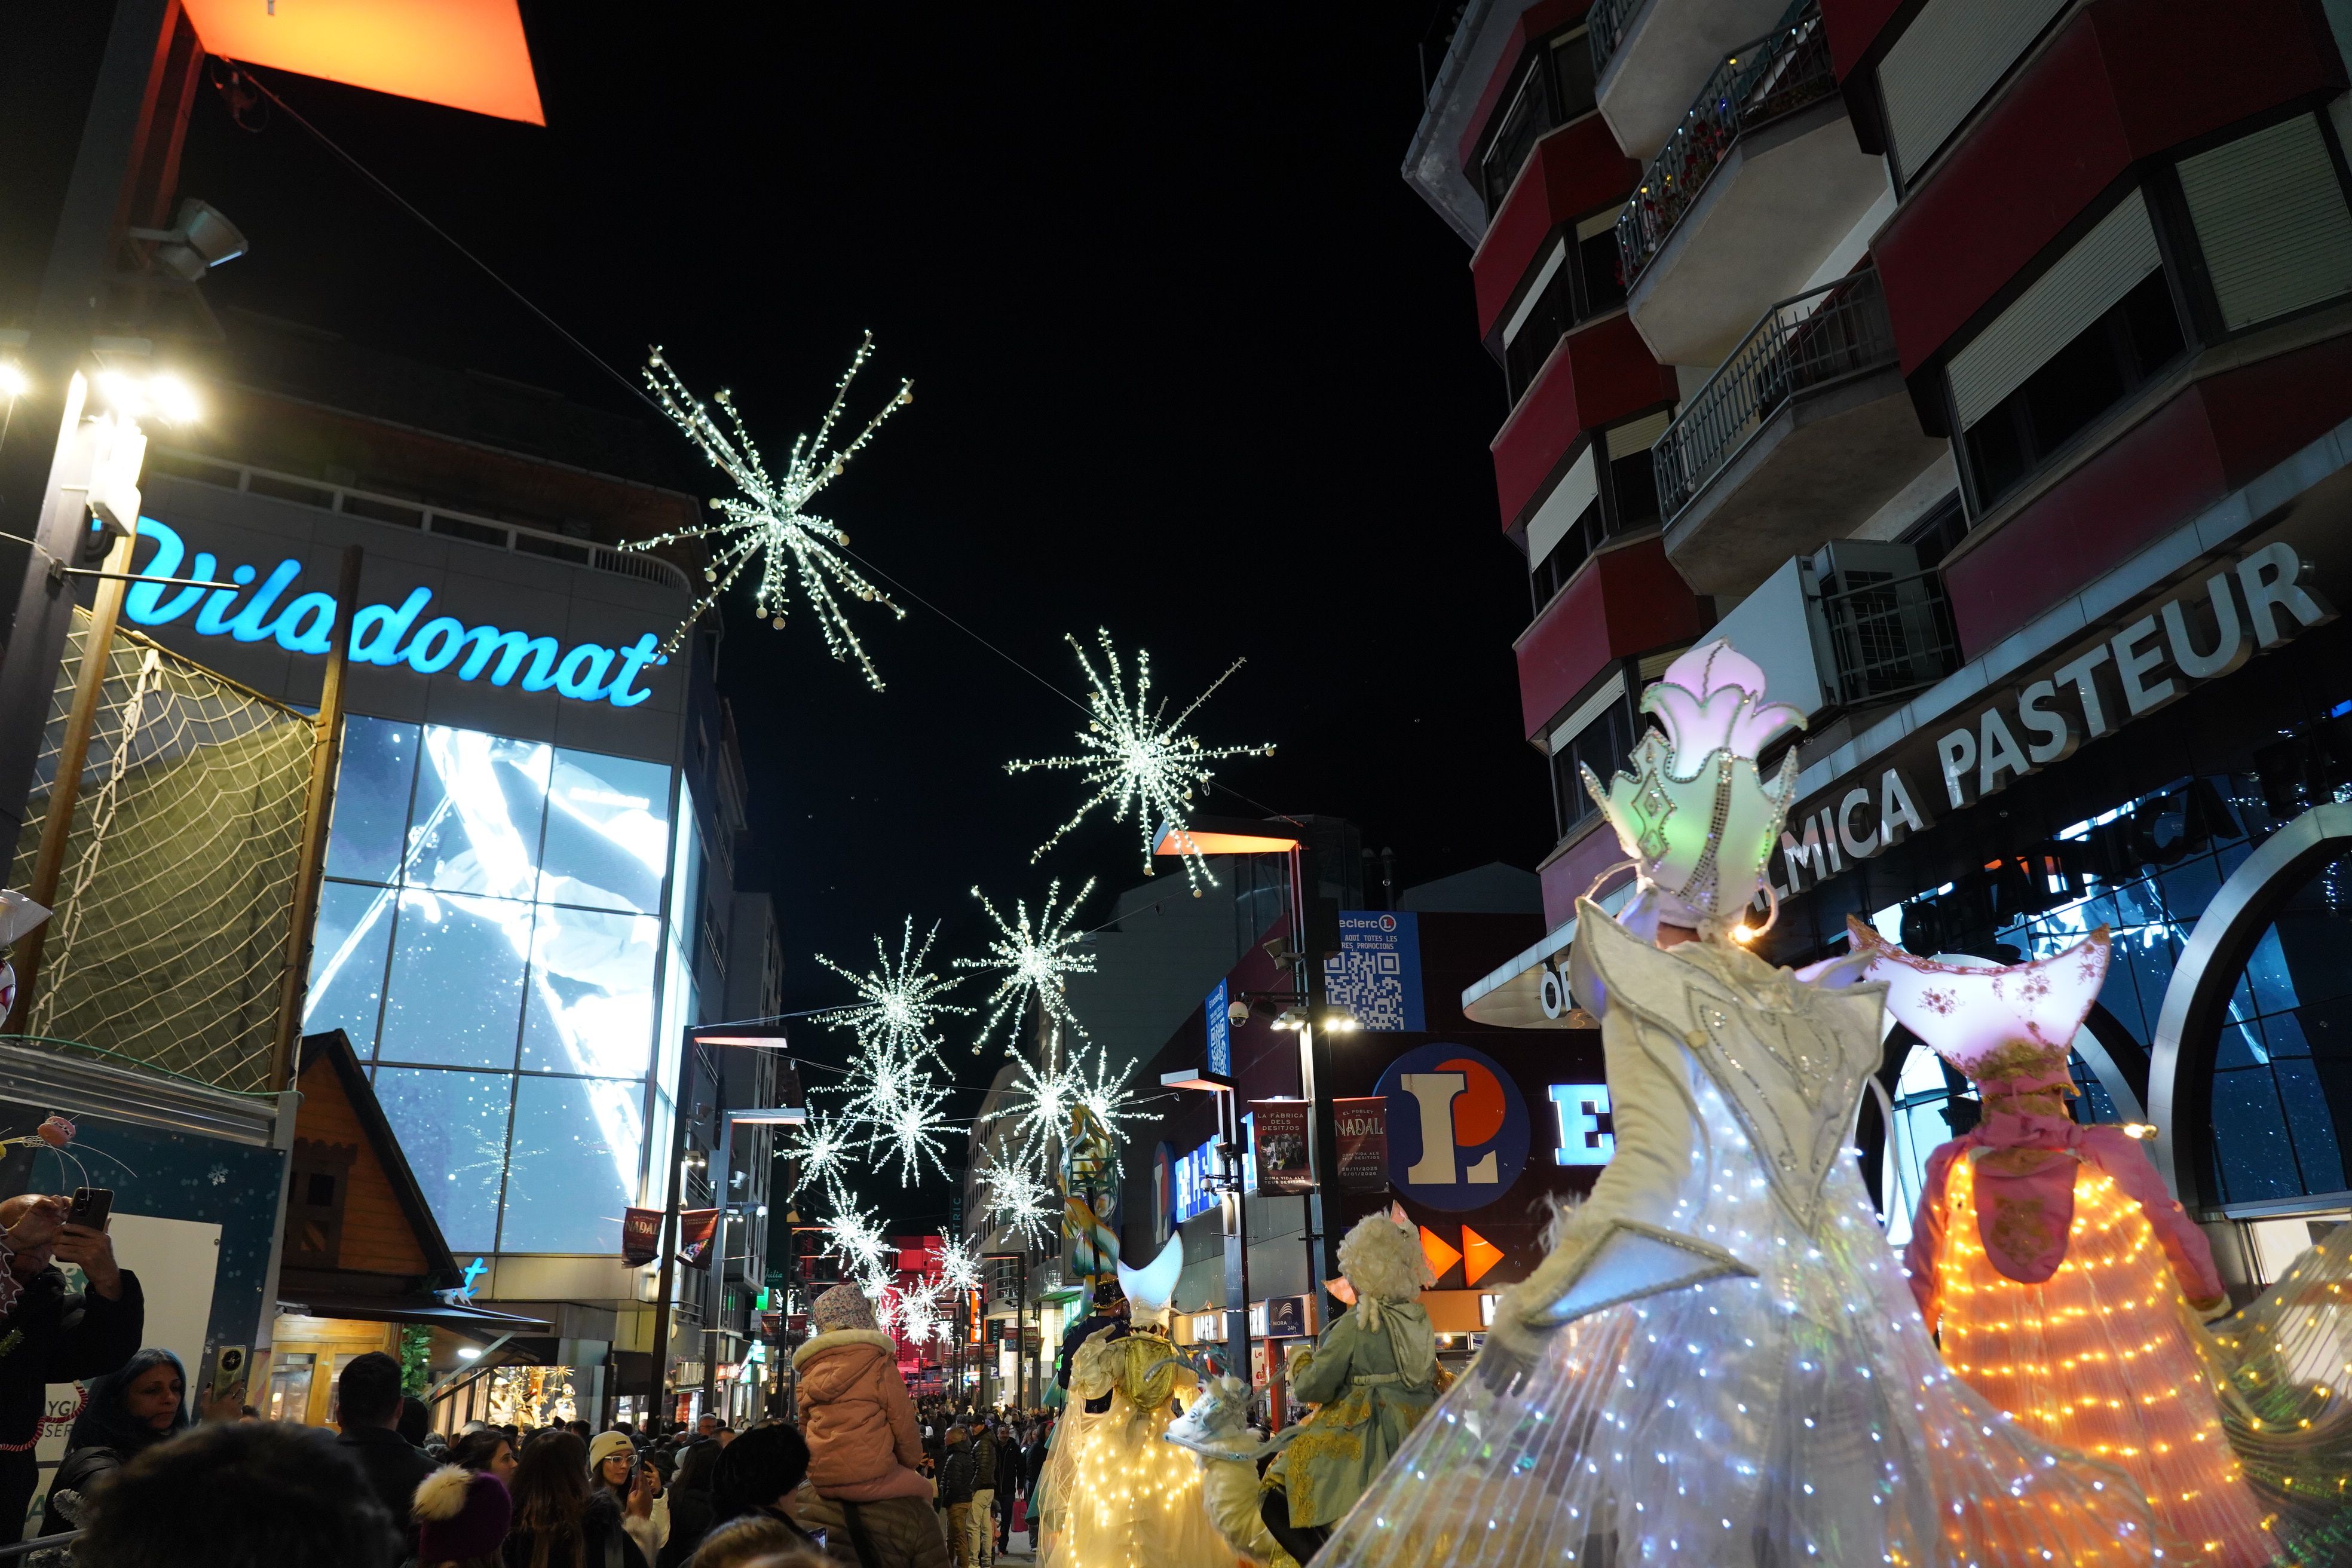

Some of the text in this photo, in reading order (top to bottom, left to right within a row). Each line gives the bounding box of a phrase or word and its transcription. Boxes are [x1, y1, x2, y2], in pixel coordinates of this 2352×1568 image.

[92, 515, 668, 708] Viladomat
[1938, 541, 2328, 810] PASTEUR
[1339, 918, 1378, 928] eclerc
[1334, 1117, 1384, 1137] NADAL
[626, 1220, 659, 1235] NADAL
